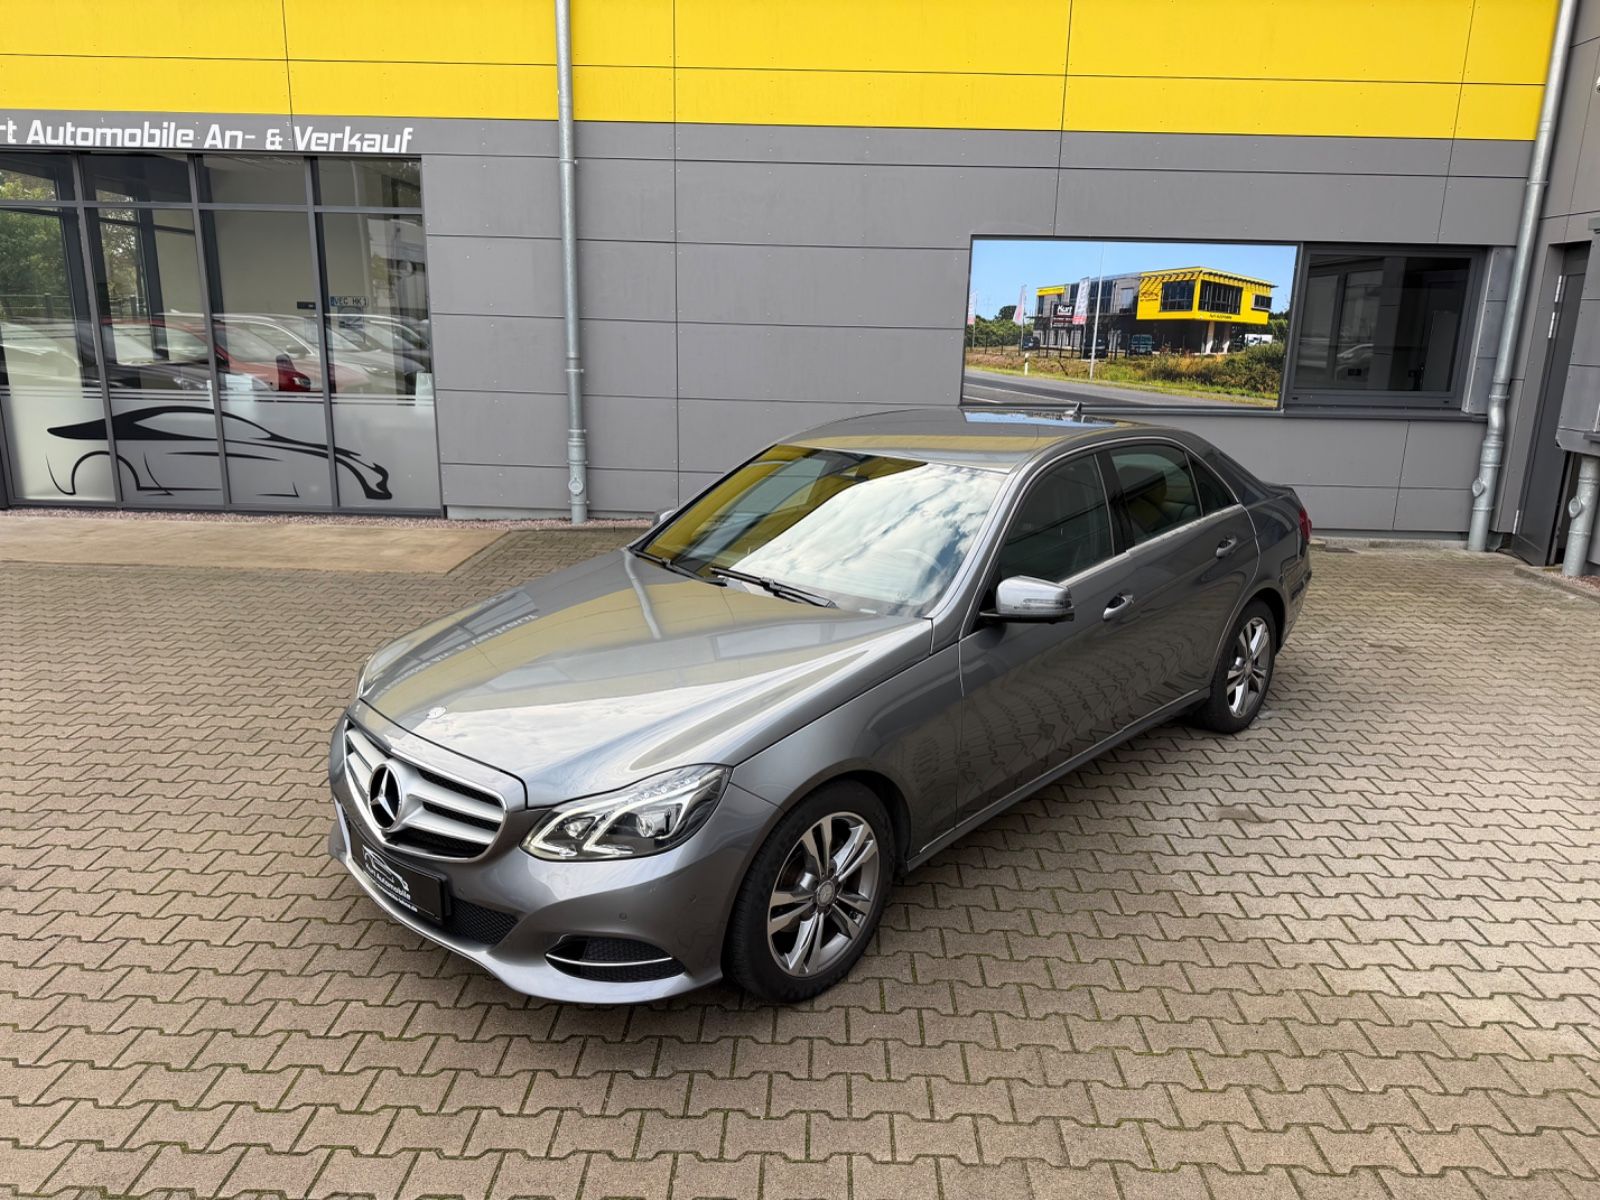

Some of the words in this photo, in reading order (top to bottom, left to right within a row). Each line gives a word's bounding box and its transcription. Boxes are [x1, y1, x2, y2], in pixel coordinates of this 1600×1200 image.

[26, 119, 194, 149] Automobile
[204, 124, 256, 150] An-
[266, 128, 283, 150] &
[294, 125, 414, 153] Verkauf
